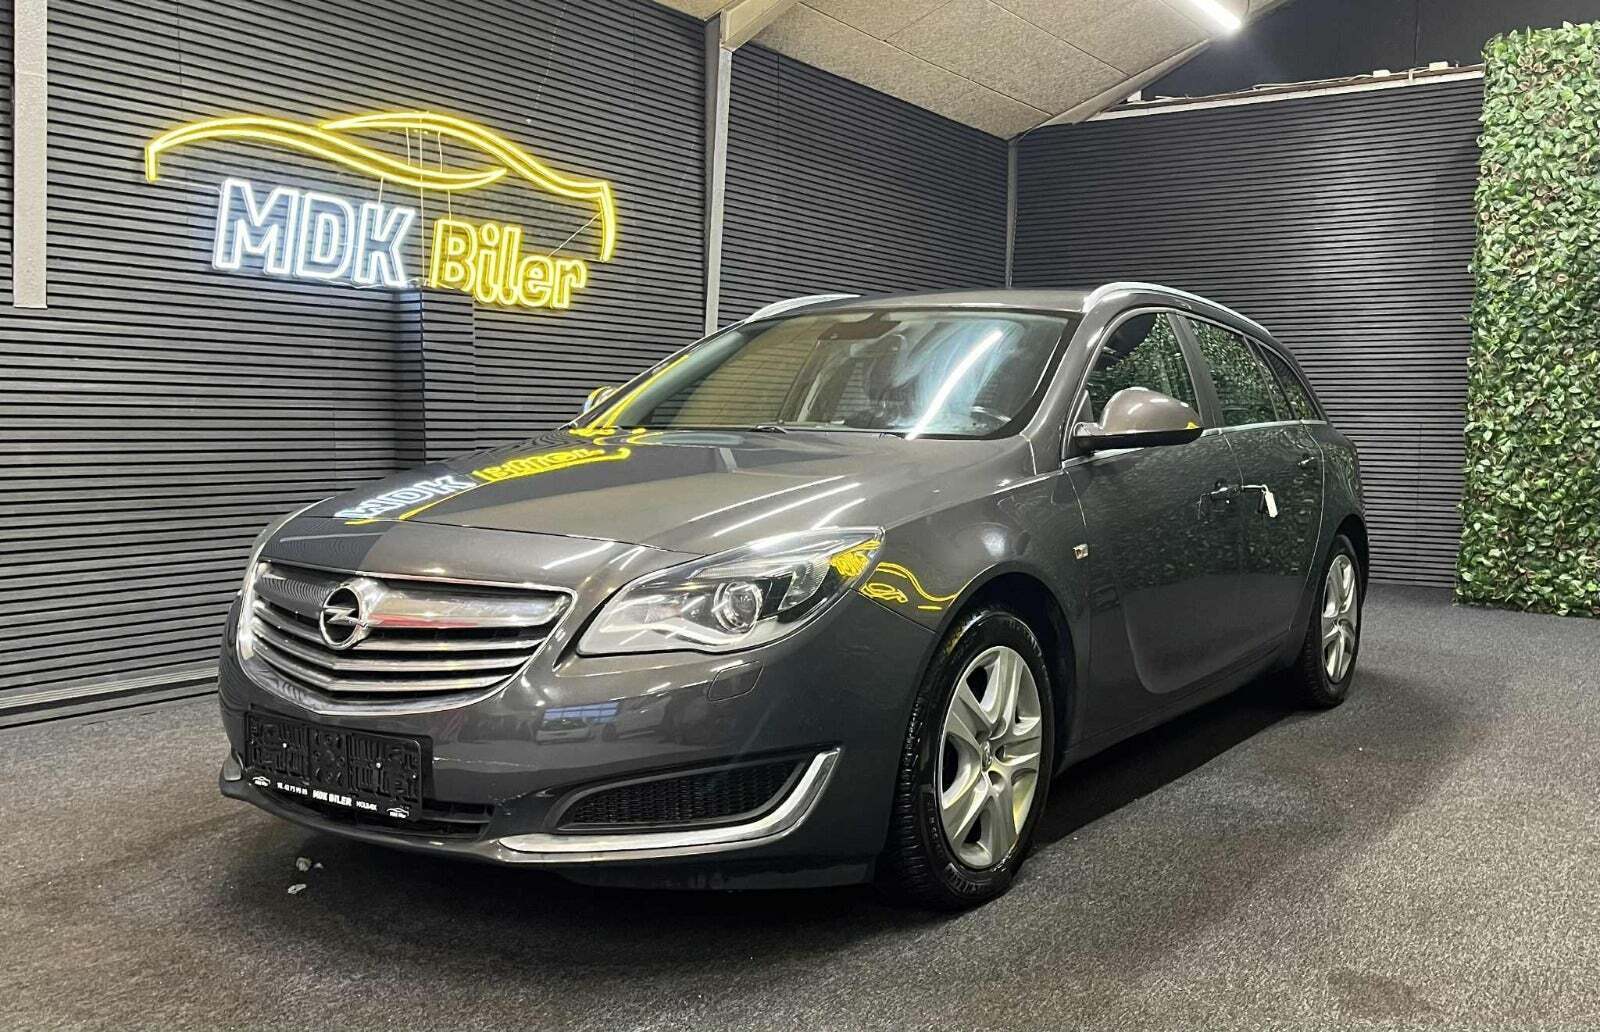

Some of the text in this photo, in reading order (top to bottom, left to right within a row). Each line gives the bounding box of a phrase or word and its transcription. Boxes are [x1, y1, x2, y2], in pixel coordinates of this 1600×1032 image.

[212, 178, 587, 308] MDK Biler
[328, 793, 352, 807] BILER
